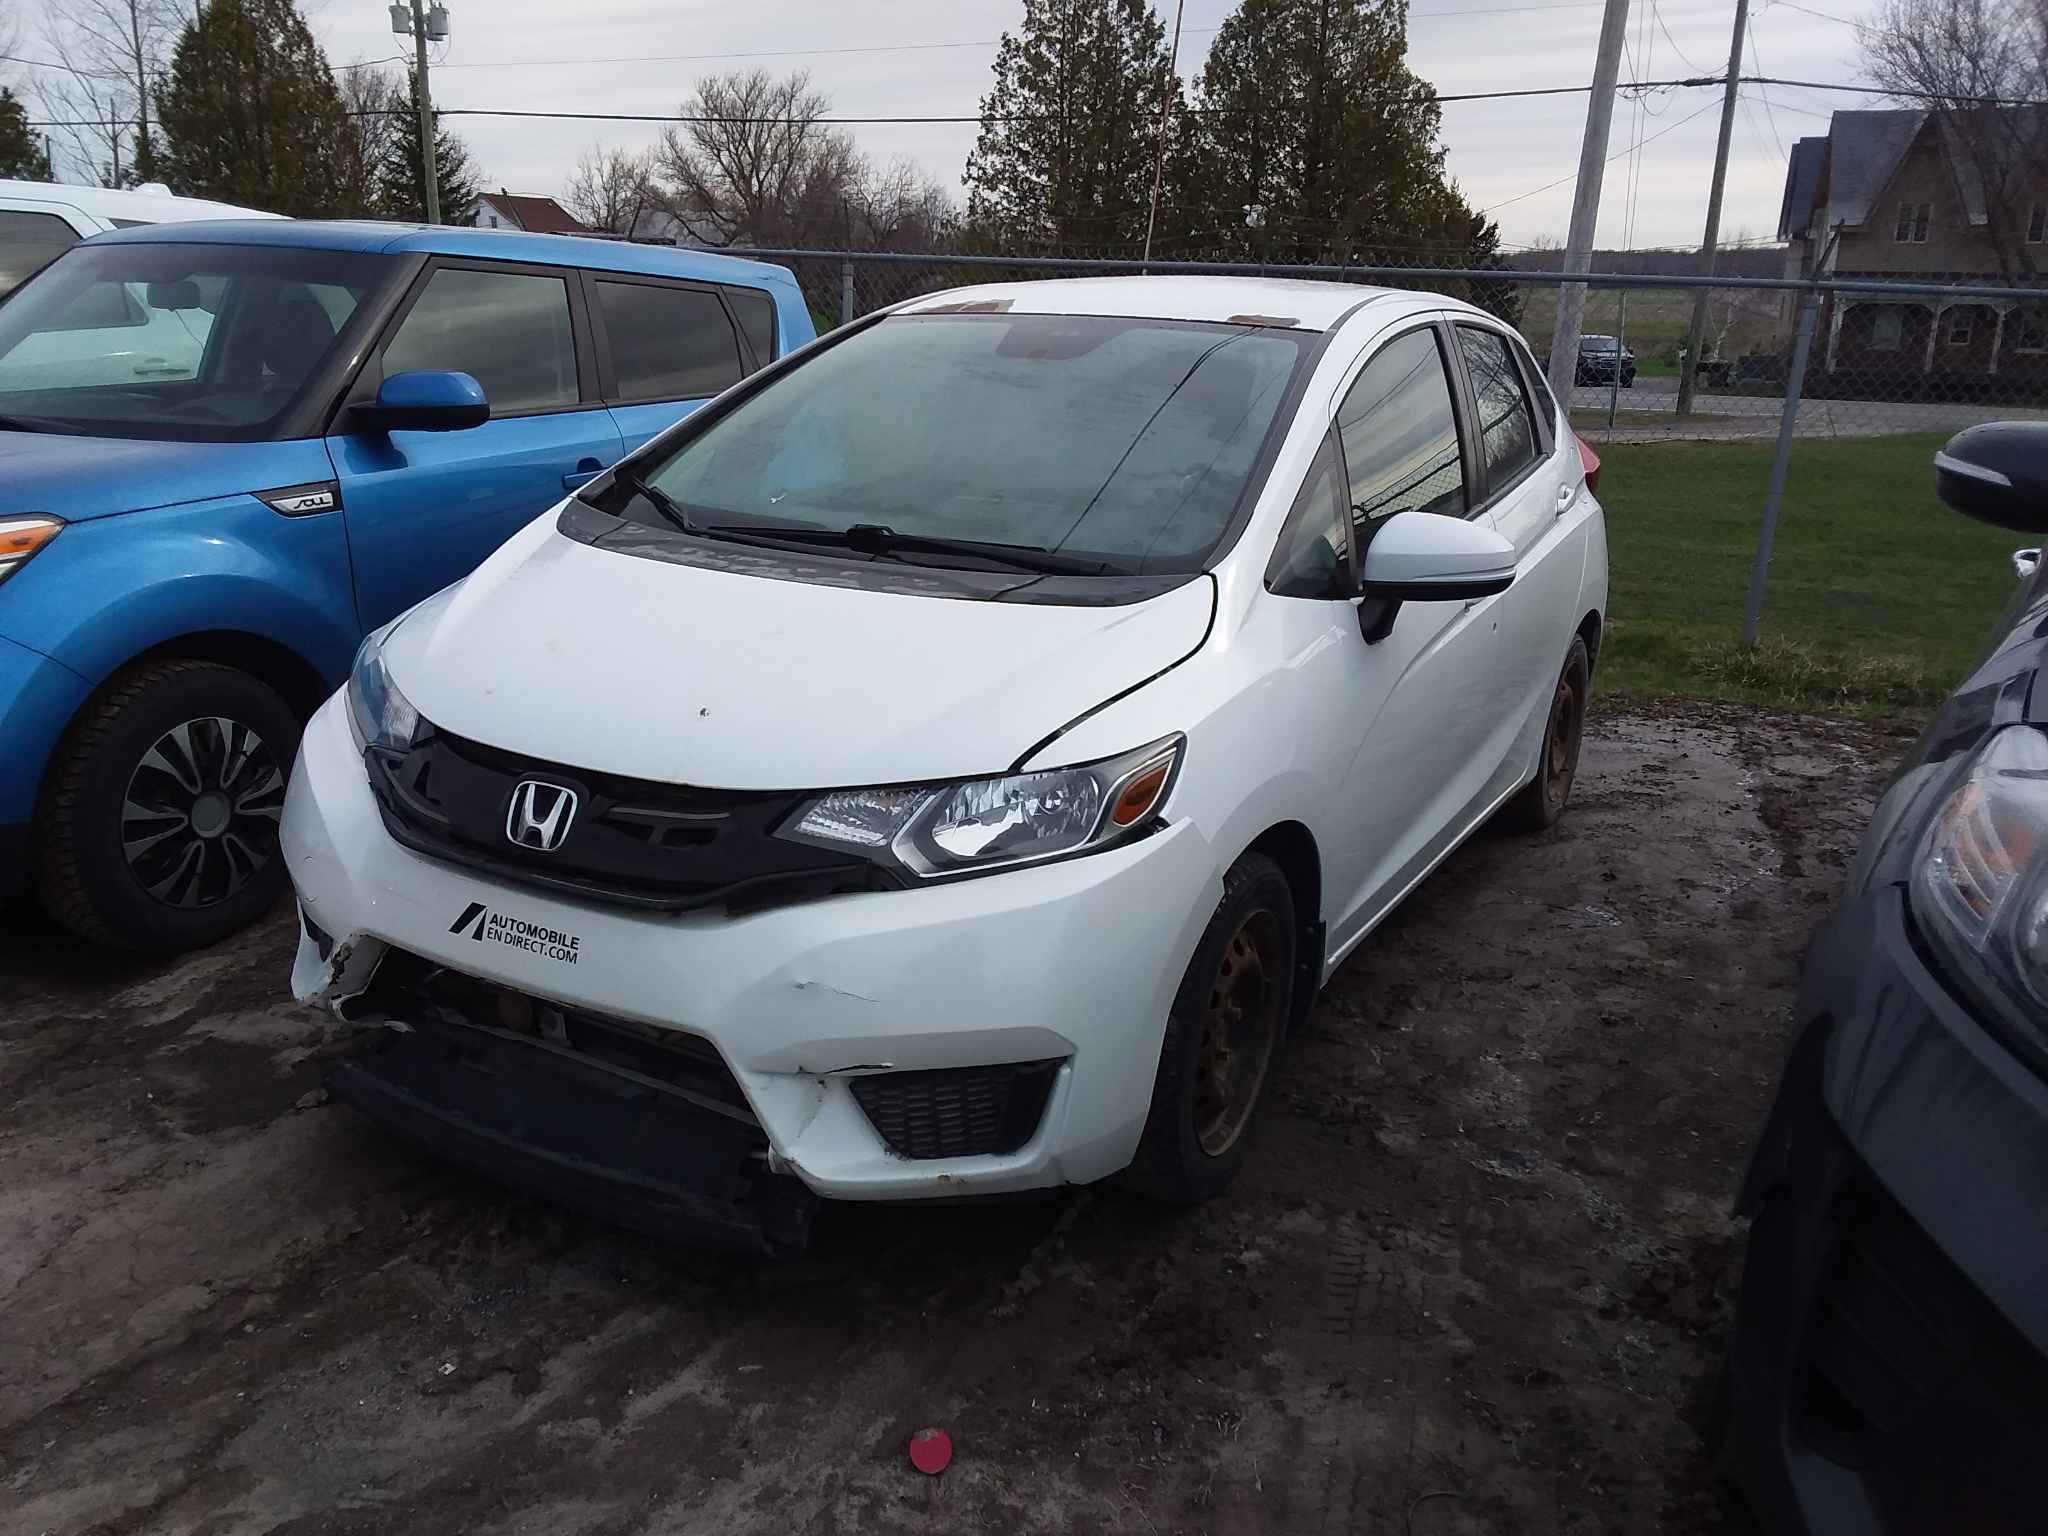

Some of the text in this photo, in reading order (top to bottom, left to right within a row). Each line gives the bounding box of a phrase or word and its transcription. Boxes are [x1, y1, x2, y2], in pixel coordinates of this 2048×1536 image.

[294, 496, 332, 509] SOUL
[486, 927, 578, 964] EN DIRECT.COM
[488, 913, 580, 950] AUTOMOBILE
